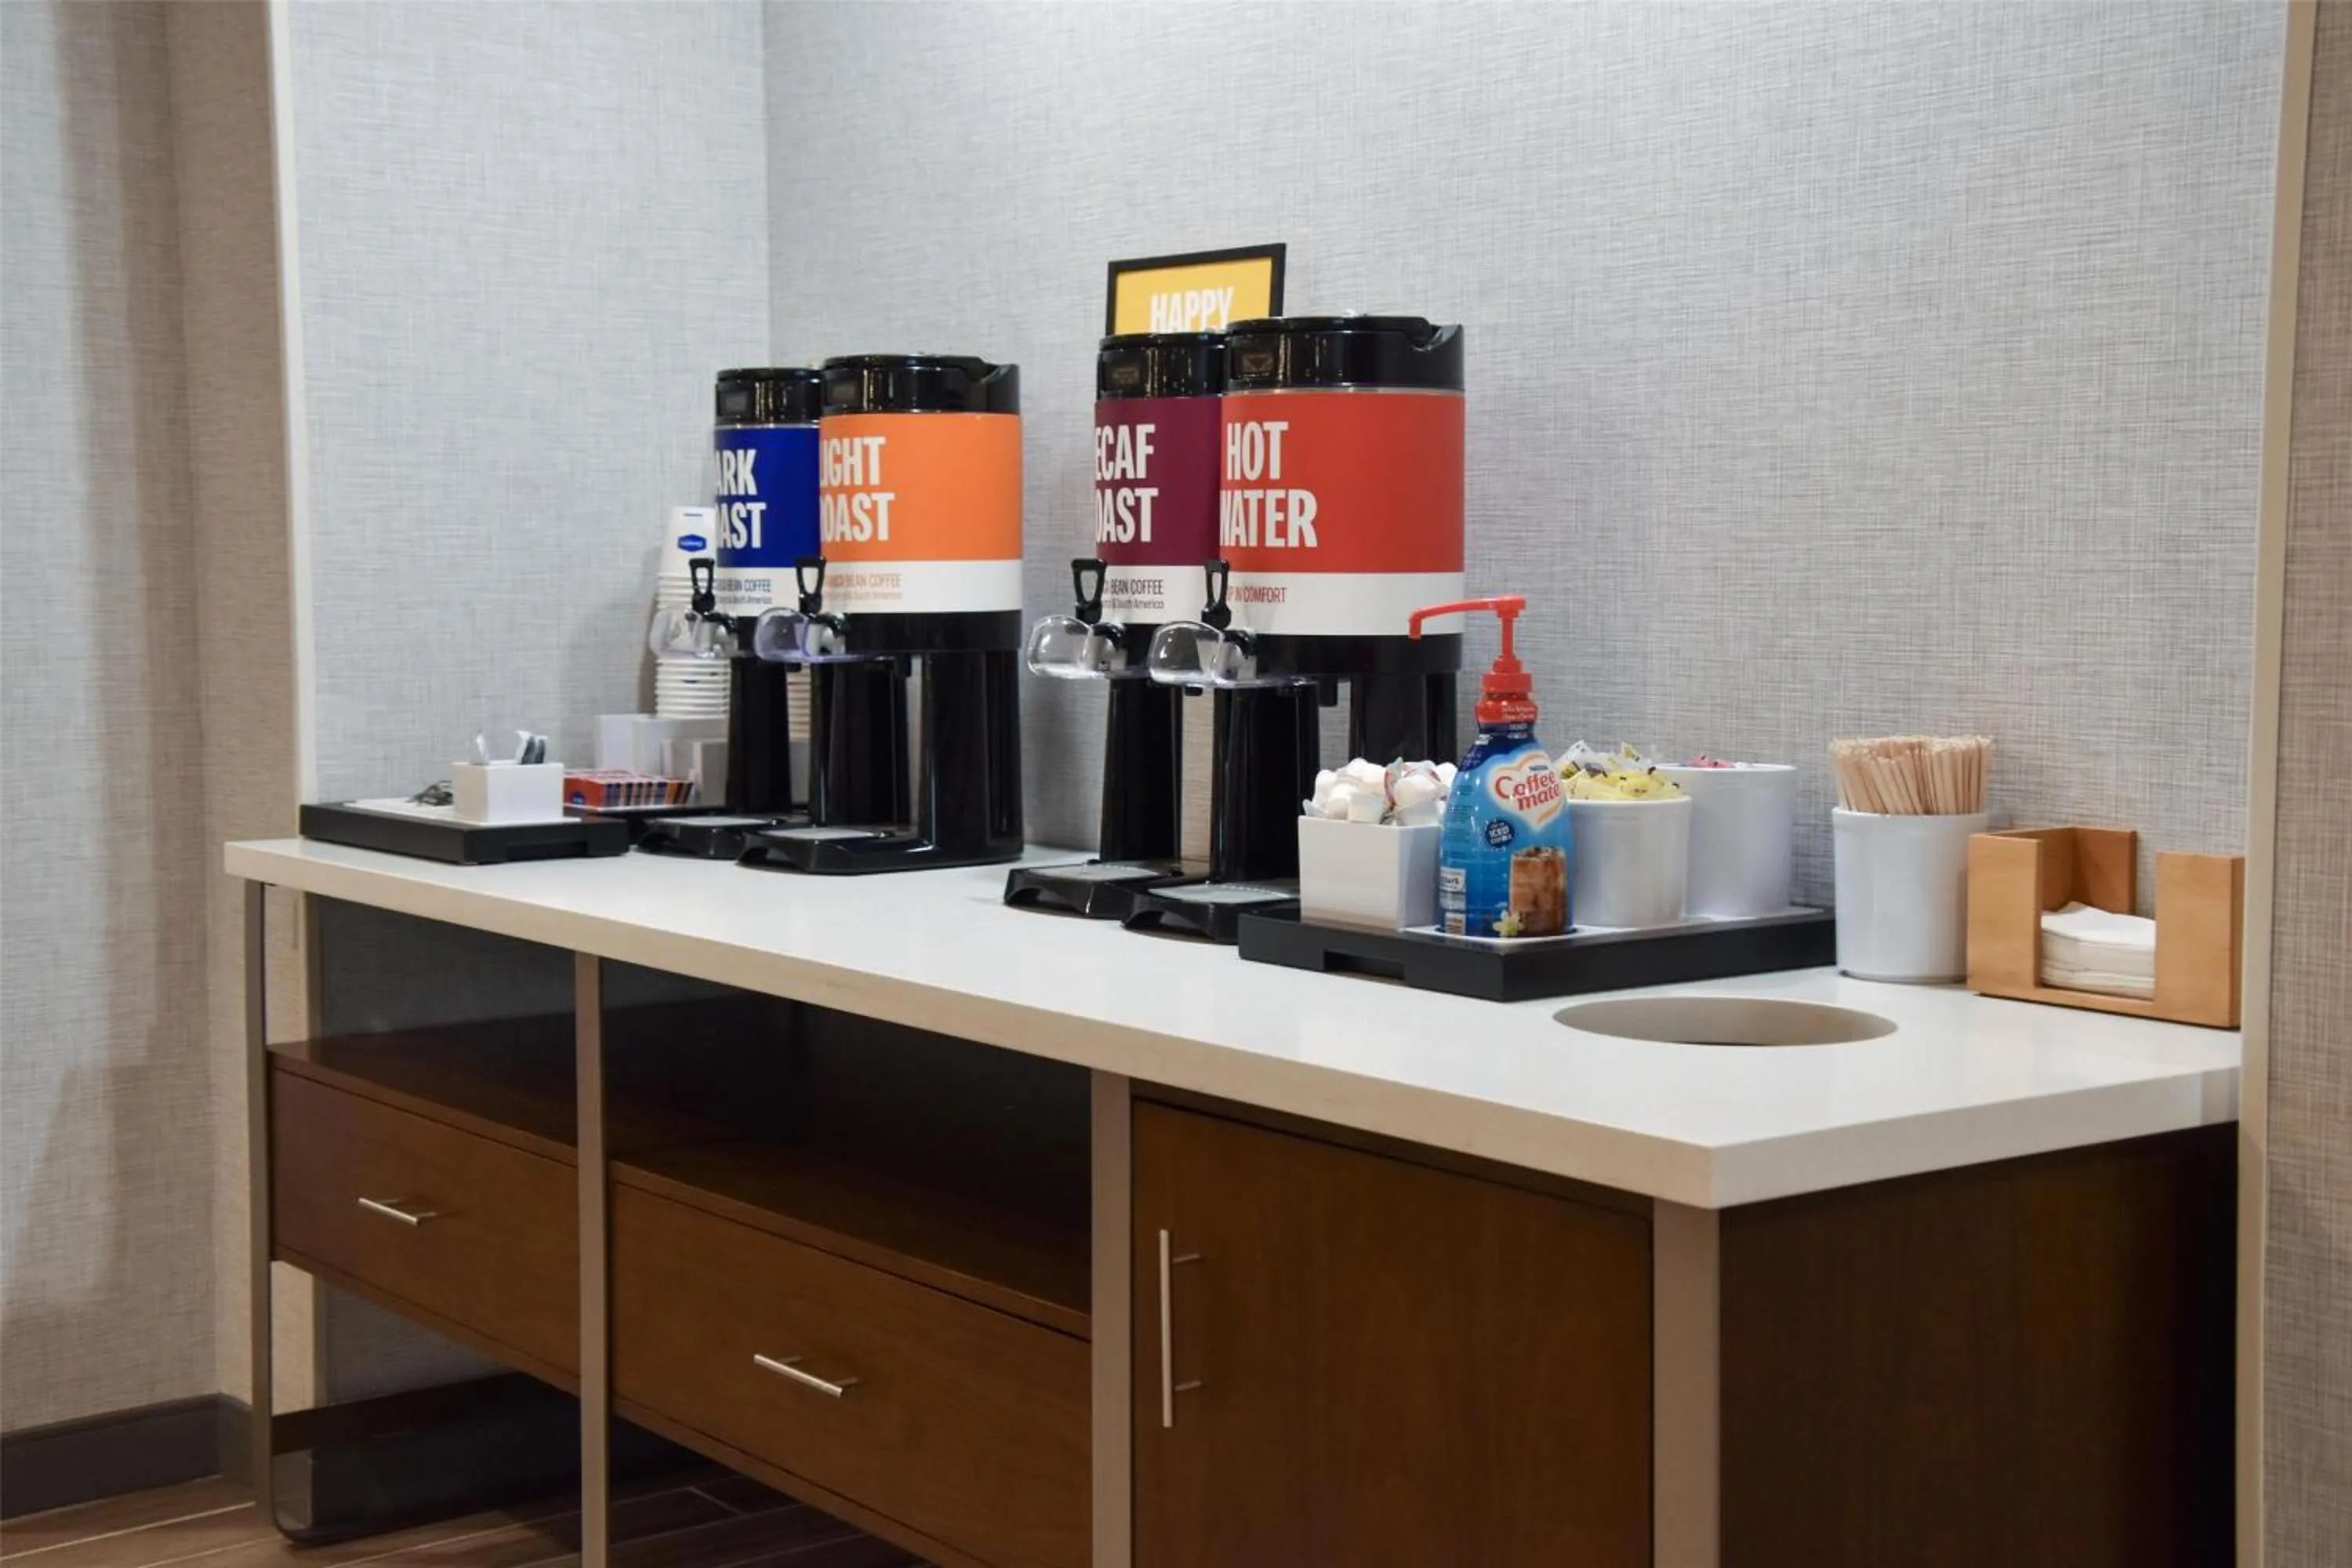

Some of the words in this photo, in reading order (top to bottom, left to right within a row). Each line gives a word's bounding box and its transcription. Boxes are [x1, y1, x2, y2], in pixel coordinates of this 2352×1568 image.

[1149, 286, 1234, 334] HAPPY
[1096, 424, 1156, 481] ECAF
[1226, 421, 1289, 481] HOT
[716, 448, 758, 495] ARK
[820, 492, 895, 543] OAST
[743, 578, 772, 593] COFFEE
[868, 572, 903, 588] COFFEE
[1110, 578, 1129, 595] BEAN
[1130, 578, 1165, 596] COFFEE
[1243, 585, 1287, 603] COMFORT
[1495, 771, 1556, 800] Coffee
[1516, 783, 1560, 811] mate
